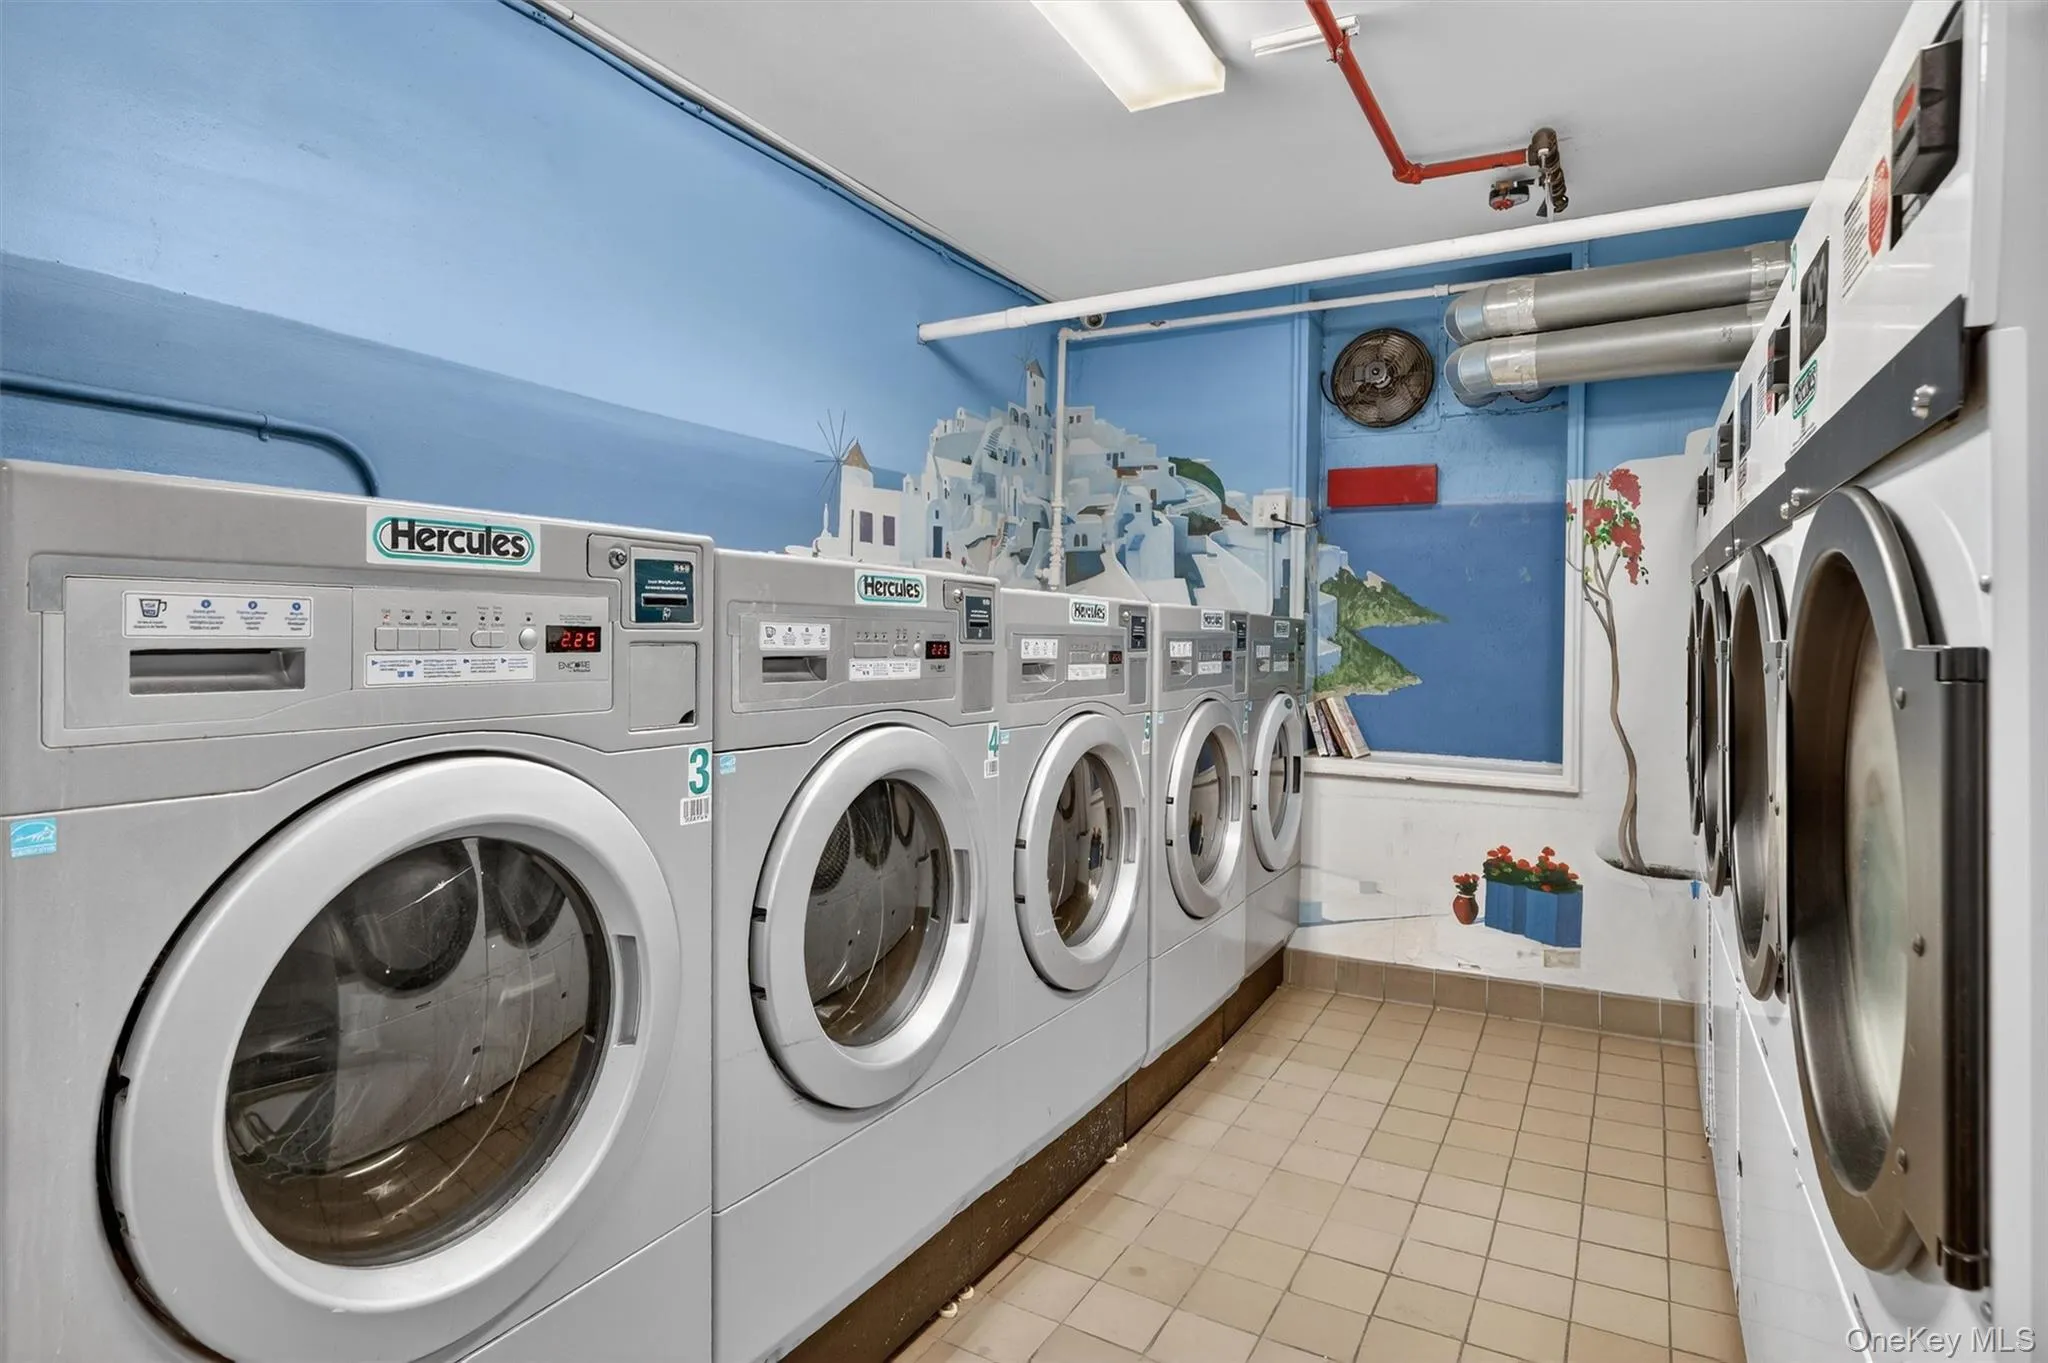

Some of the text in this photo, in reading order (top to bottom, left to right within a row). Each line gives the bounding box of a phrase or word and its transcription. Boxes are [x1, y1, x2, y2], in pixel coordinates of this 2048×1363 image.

[391, 518, 526, 558] Hercules
[864, 576, 921, 598] Hercules
[561, 632, 596, 648] 2.25
[989, 726, 999, 757] 4
[688, 748, 710, 795] 3
